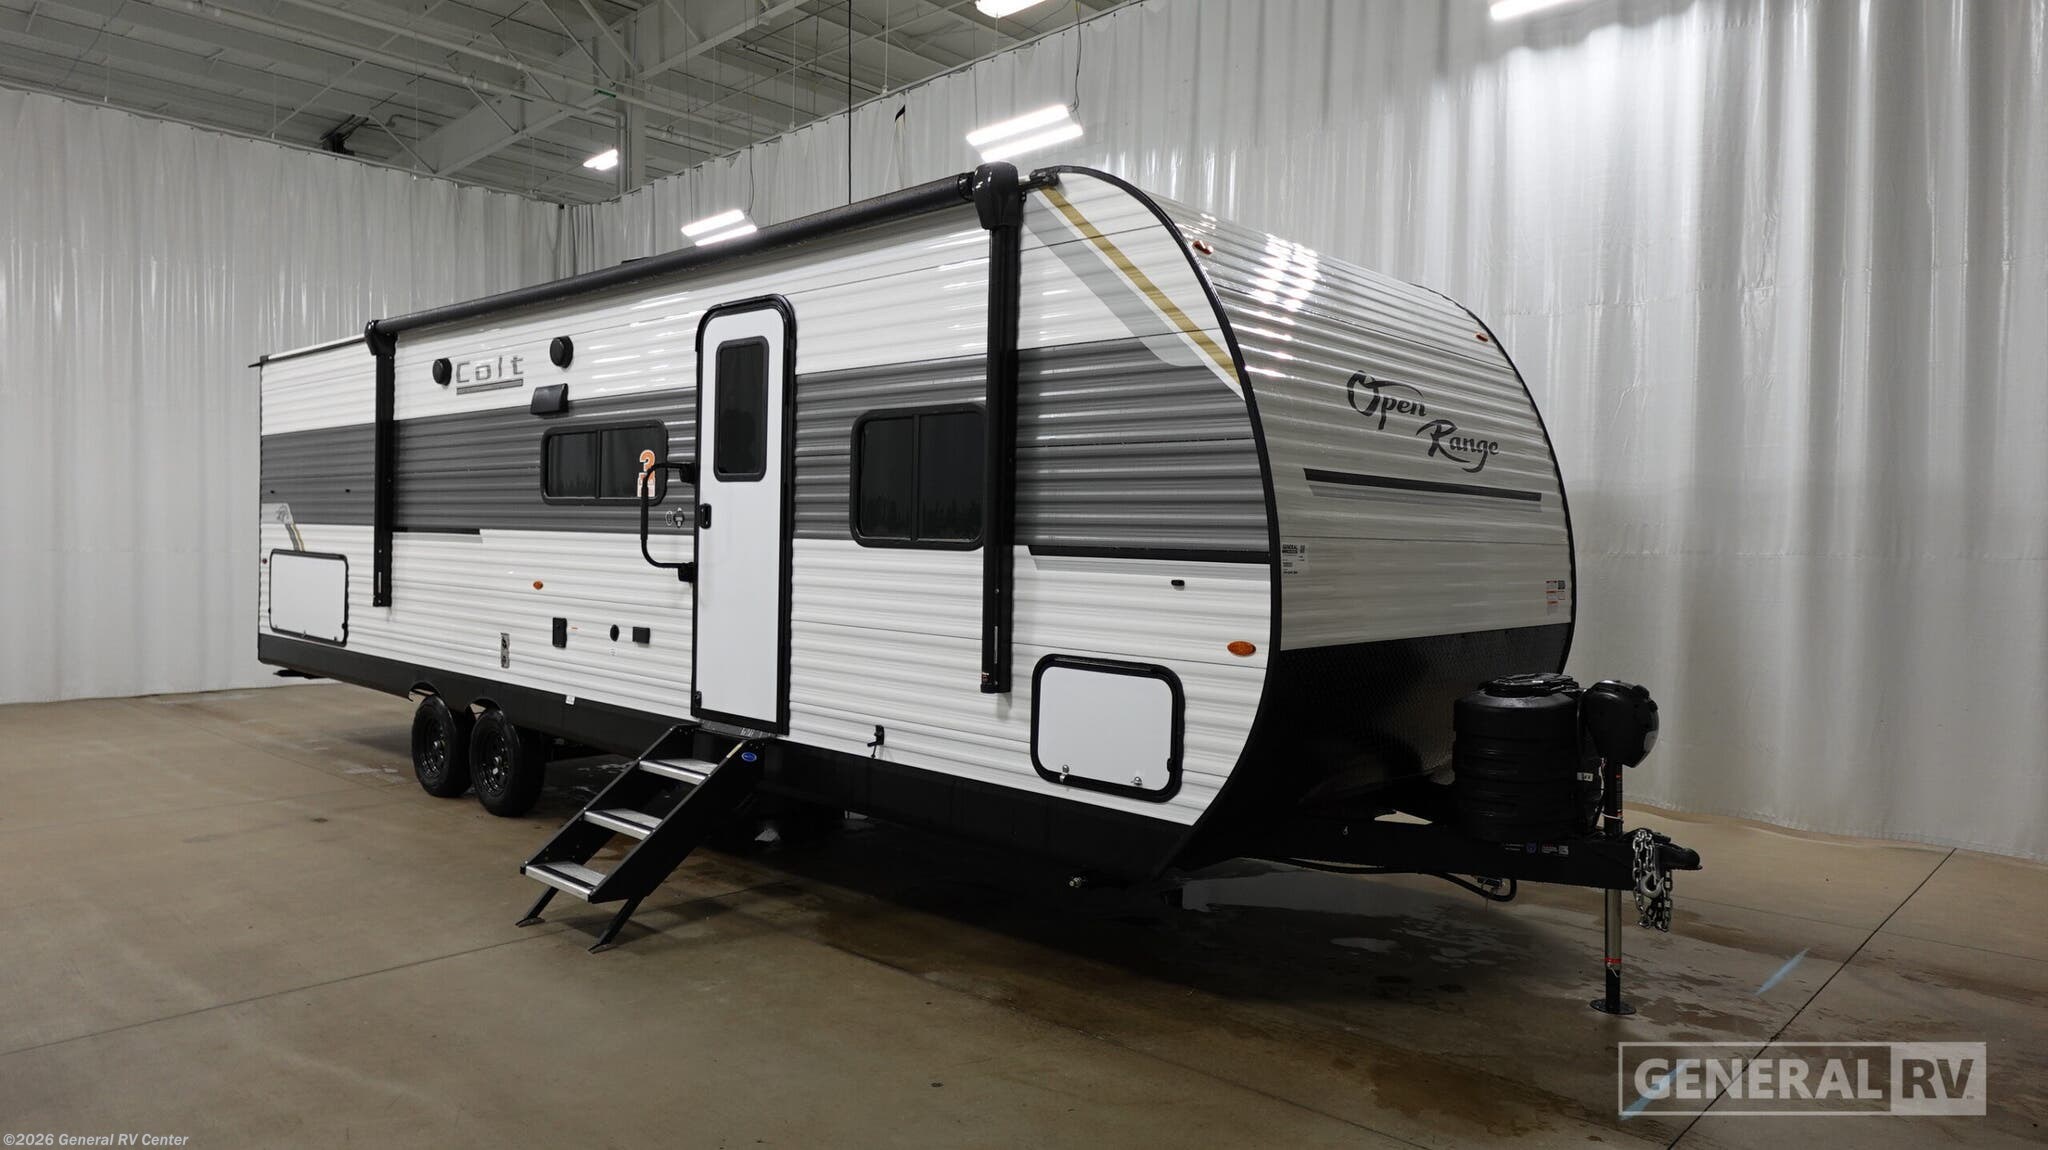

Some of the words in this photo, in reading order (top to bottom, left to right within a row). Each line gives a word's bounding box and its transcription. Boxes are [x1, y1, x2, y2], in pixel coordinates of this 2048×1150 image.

[456, 355, 524, 383] Colt
[1347, 370, 1426, 430] Open
[1416, 419, 1499, 473] Range
